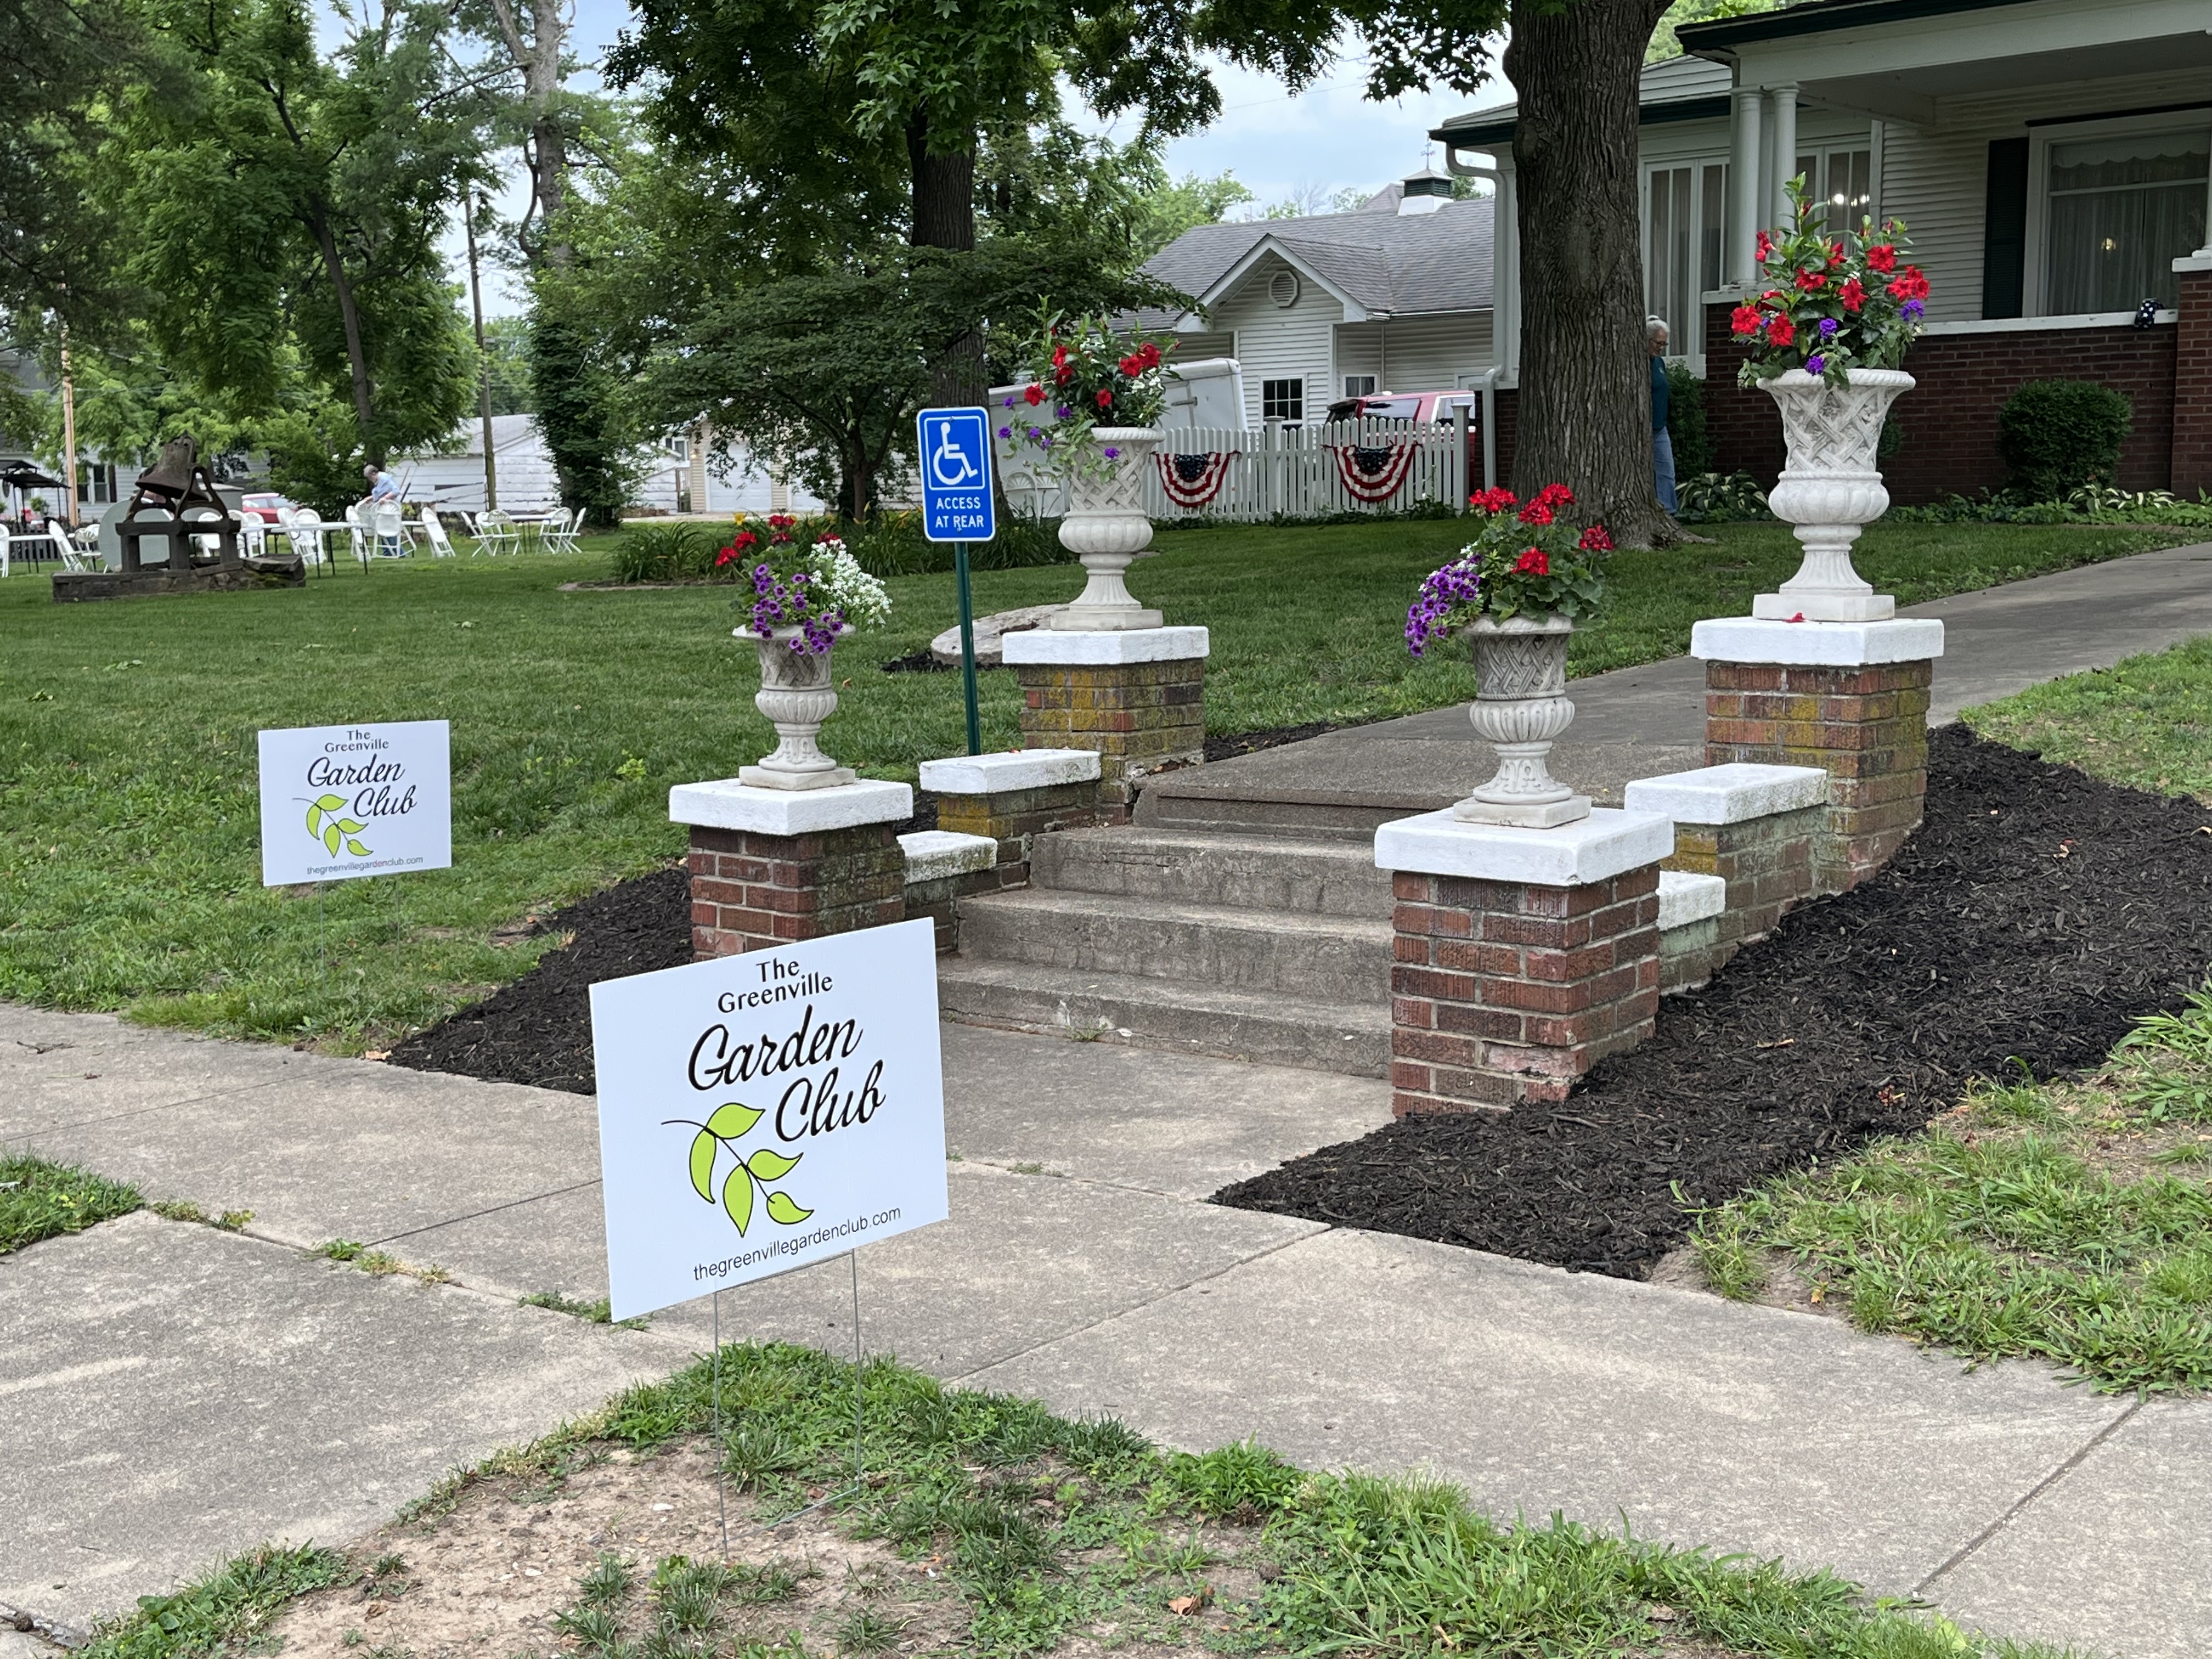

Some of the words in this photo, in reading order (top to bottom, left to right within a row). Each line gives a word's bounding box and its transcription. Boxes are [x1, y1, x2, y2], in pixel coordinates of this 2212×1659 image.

[936, 496, 981, 510] ACCESS
[935, 515, 949, 528] AT
[953, 515, 984, 528] REAR
[324, 738, 390, 753] Greenville
[346, 729, 371, 741] The
[307, 753, 405, 787] Garden
[353, 785, 417, 817] Club
[307, 856, 424, 876] thegreenvillegardenclub.com
[755, 957, 800, 983] The
[717, 971, 833, 1014] Greenville
[687, 1003, 864, 1091] Garden
[775, 1059, 887, 1143] Club
[693, 1206, 901, 1281] thegreenvillegardenclub.com
